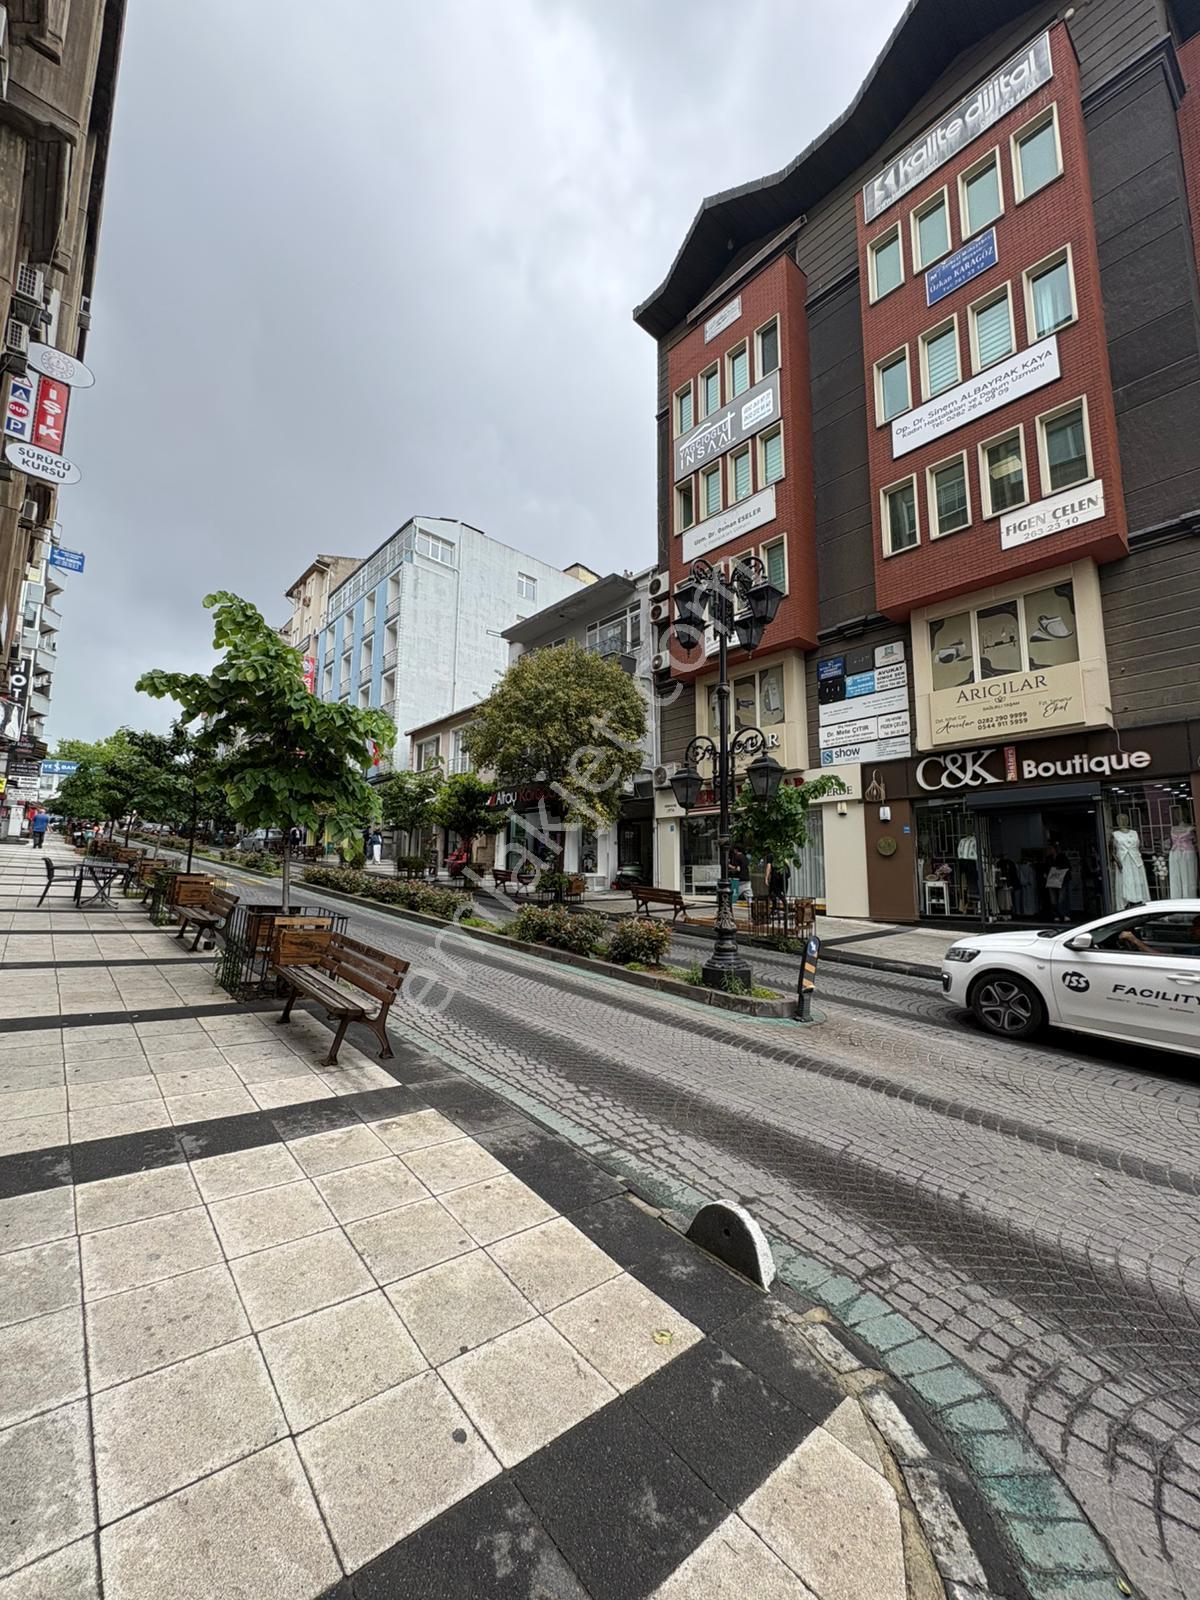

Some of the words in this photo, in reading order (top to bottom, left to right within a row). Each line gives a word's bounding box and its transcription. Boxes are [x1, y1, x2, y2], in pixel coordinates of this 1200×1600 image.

[895, 424, 911, 437] Op.
[912, 416, 926, 427] Dr.
[927, 399, 958, 418] Sinem
[960, 366, 1018, 403] ALBAYRAK
[1021, 350, 1053, 370] KAYA
[981, 380, 1010, 398] Doğum
[9, 404, 28, 415] DUR
[17, 446, 72, 472] SÜRÜCÜ
[21, 458, 66, 479] KURSU
[1047, 522, 1061, 533] 23
[1065, 515, 1079, 526] 10
[956, 674, 1048, 704] ARICILAR
[834, 747, 860, 759] show
[915, 748, 1005, 791] C&K
[1022, 750, 1151, 780] Boutique
